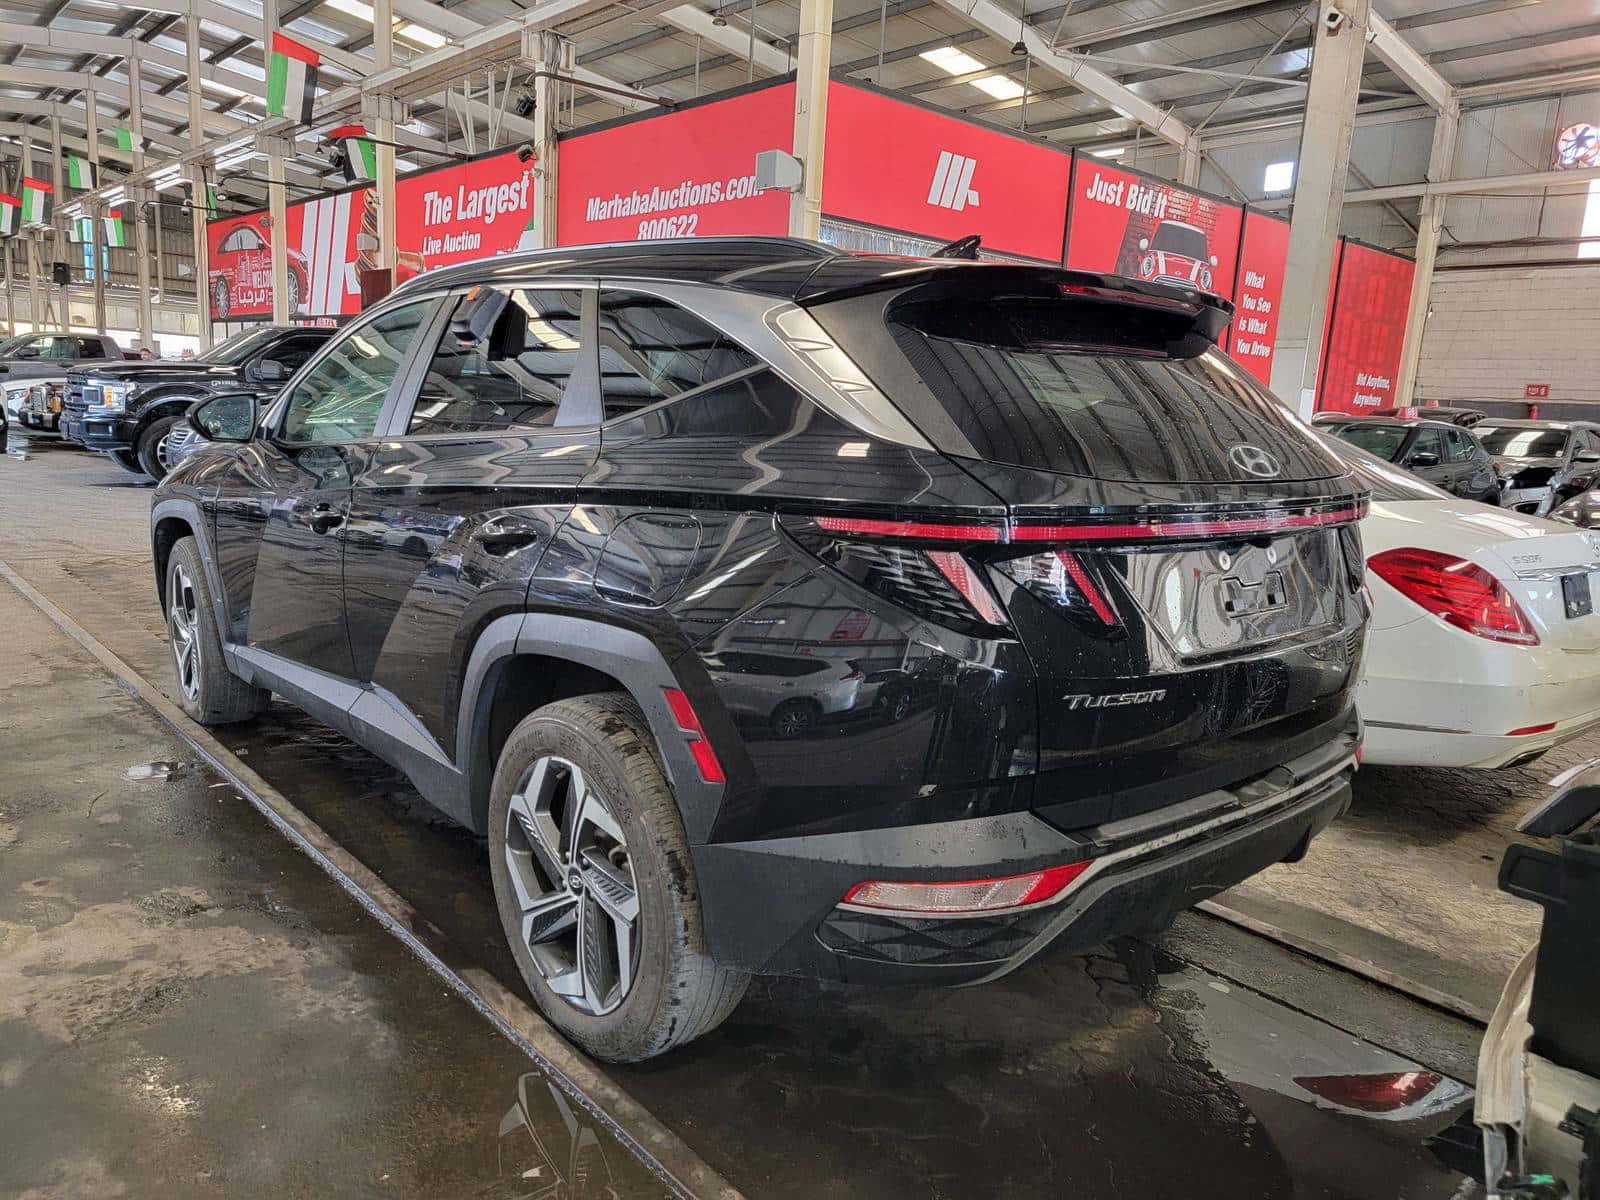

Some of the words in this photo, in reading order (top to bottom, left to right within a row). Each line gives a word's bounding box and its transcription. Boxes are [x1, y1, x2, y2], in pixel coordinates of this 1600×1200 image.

[424, 191, 452, 226] The
[457, 170, 529, 224] Largest
[1086, 173, 1124, 207] Just
[1125, 183, 1154, 214] Bid
[637, 213, 698, 240] 800622
[423, 235, 441, 256] Live
[443, 230, 481, 253] Auction
[1245, 271, 1265, 289] What
[1242, 293, 1256, 309] You
[1257, 297, 1272, 313] See
[1238, 316, 1246, 331] Is
[1247, 318, 1268, 335] What
[1236, 338, 1250, 354] You
[1251, 341, 1271, 357] Drive
[1062, 689, 1167, 710] TUCSON
